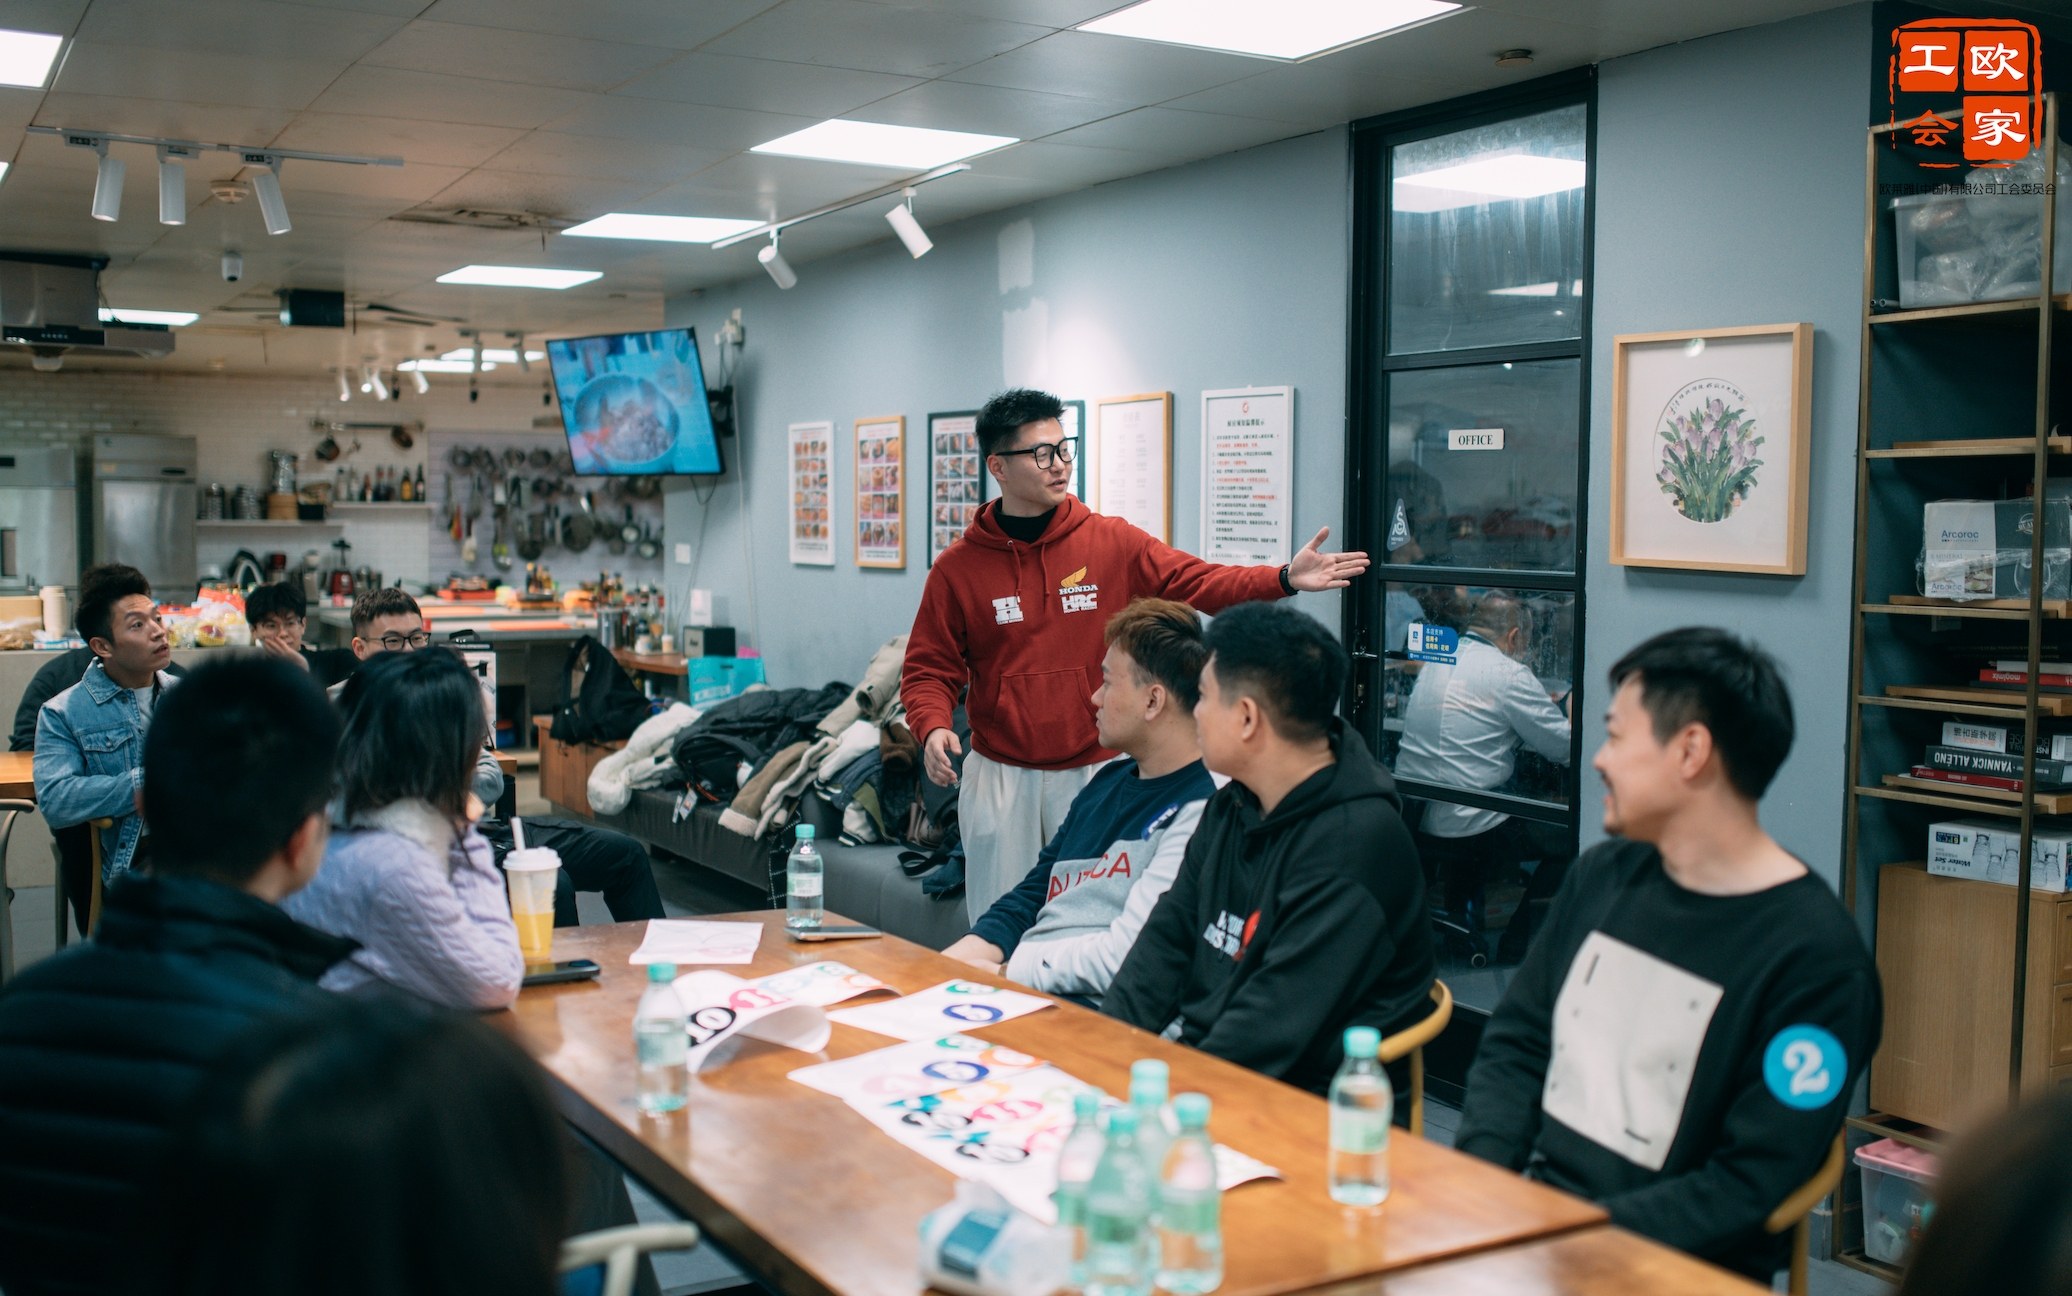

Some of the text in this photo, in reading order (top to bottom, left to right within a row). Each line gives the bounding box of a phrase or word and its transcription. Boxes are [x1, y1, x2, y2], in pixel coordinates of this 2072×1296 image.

[1458, 435, 1493, 445] OFFICE
[1059, 585, 1099, 595] HONDA
[1934, 751, 1970, 767] ALLÉNO
[1972, 756, 2012, 773] YANNICK
[1947, 859, 1971, 868] Water
[1783, 1040, 1829, 1096] 2
